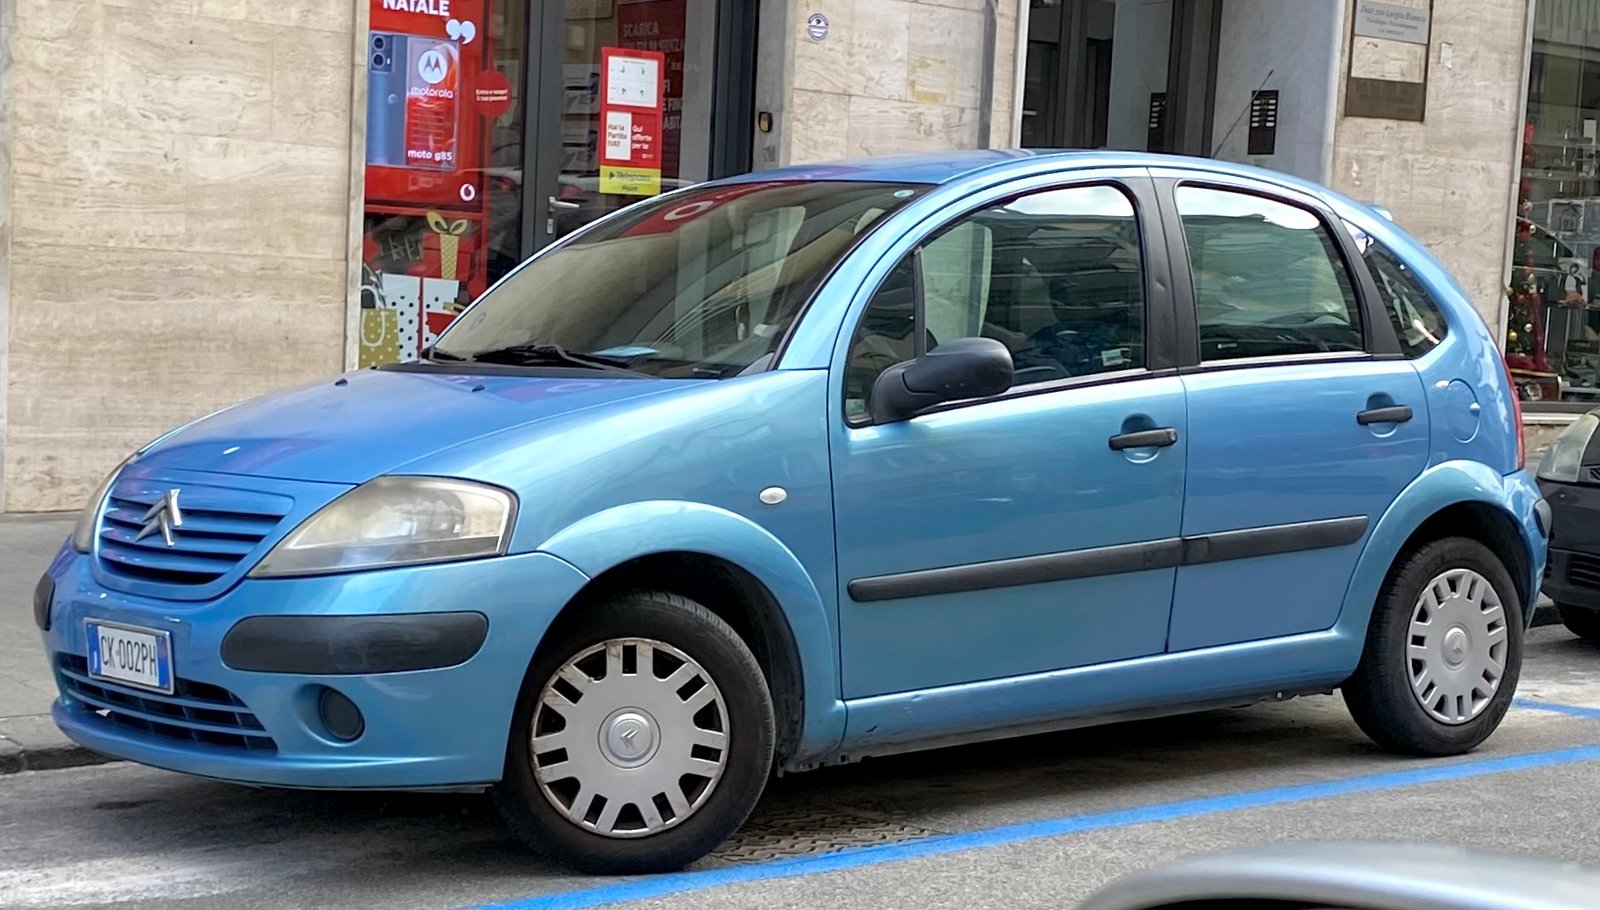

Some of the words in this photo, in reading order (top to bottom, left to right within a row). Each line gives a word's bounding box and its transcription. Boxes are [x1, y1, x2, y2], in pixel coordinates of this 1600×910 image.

[383, 0, 450, 17] NATALE
[410, 86, 454, 99] motorola
[407, 148, 433, 159] moto
[434, 151, 453, 162] g85
